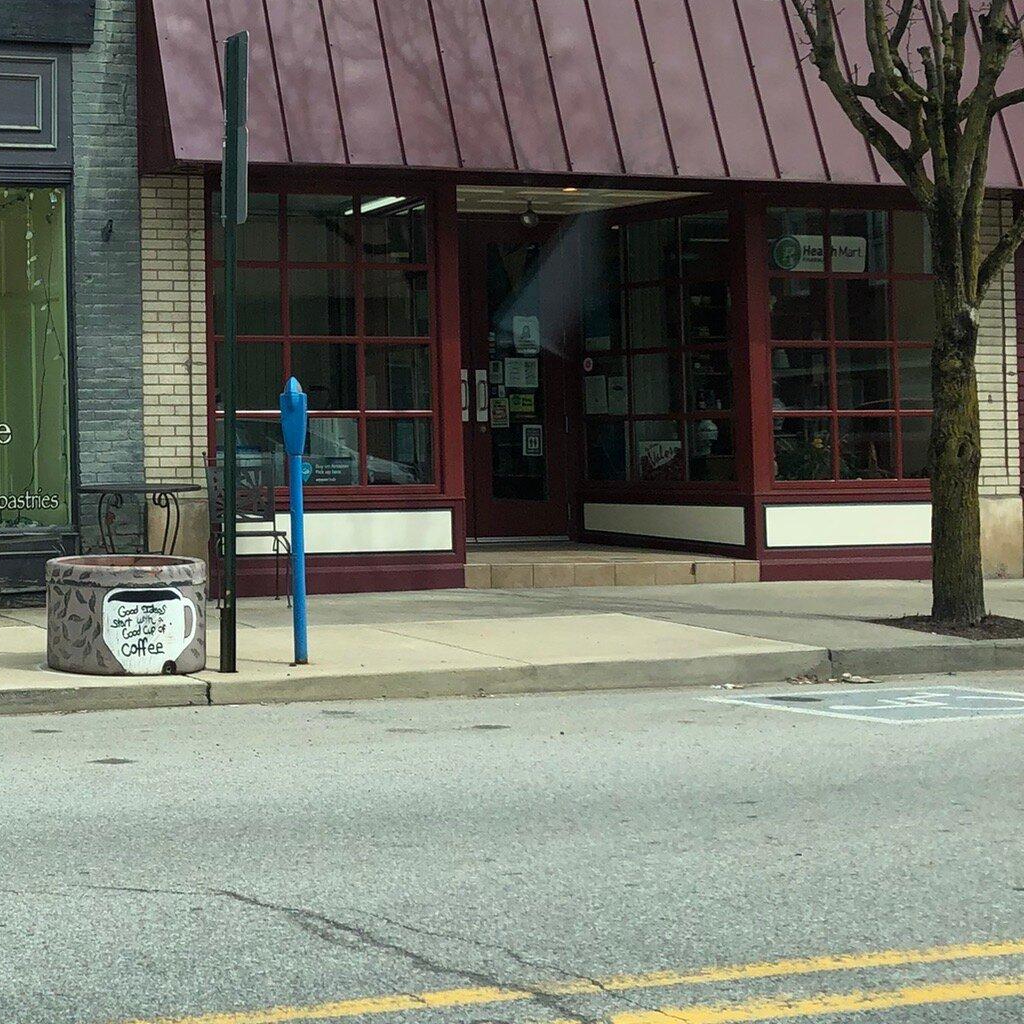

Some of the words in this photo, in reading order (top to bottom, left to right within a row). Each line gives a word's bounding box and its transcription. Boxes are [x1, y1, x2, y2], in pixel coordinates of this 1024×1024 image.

[802, 244, 837, 257] Heah
[839, 245, 864, 258] Mart
[117, 605, 139, 618] Good
[122, 625, 141, 640] Good
[157, 624, 166, 634] of
